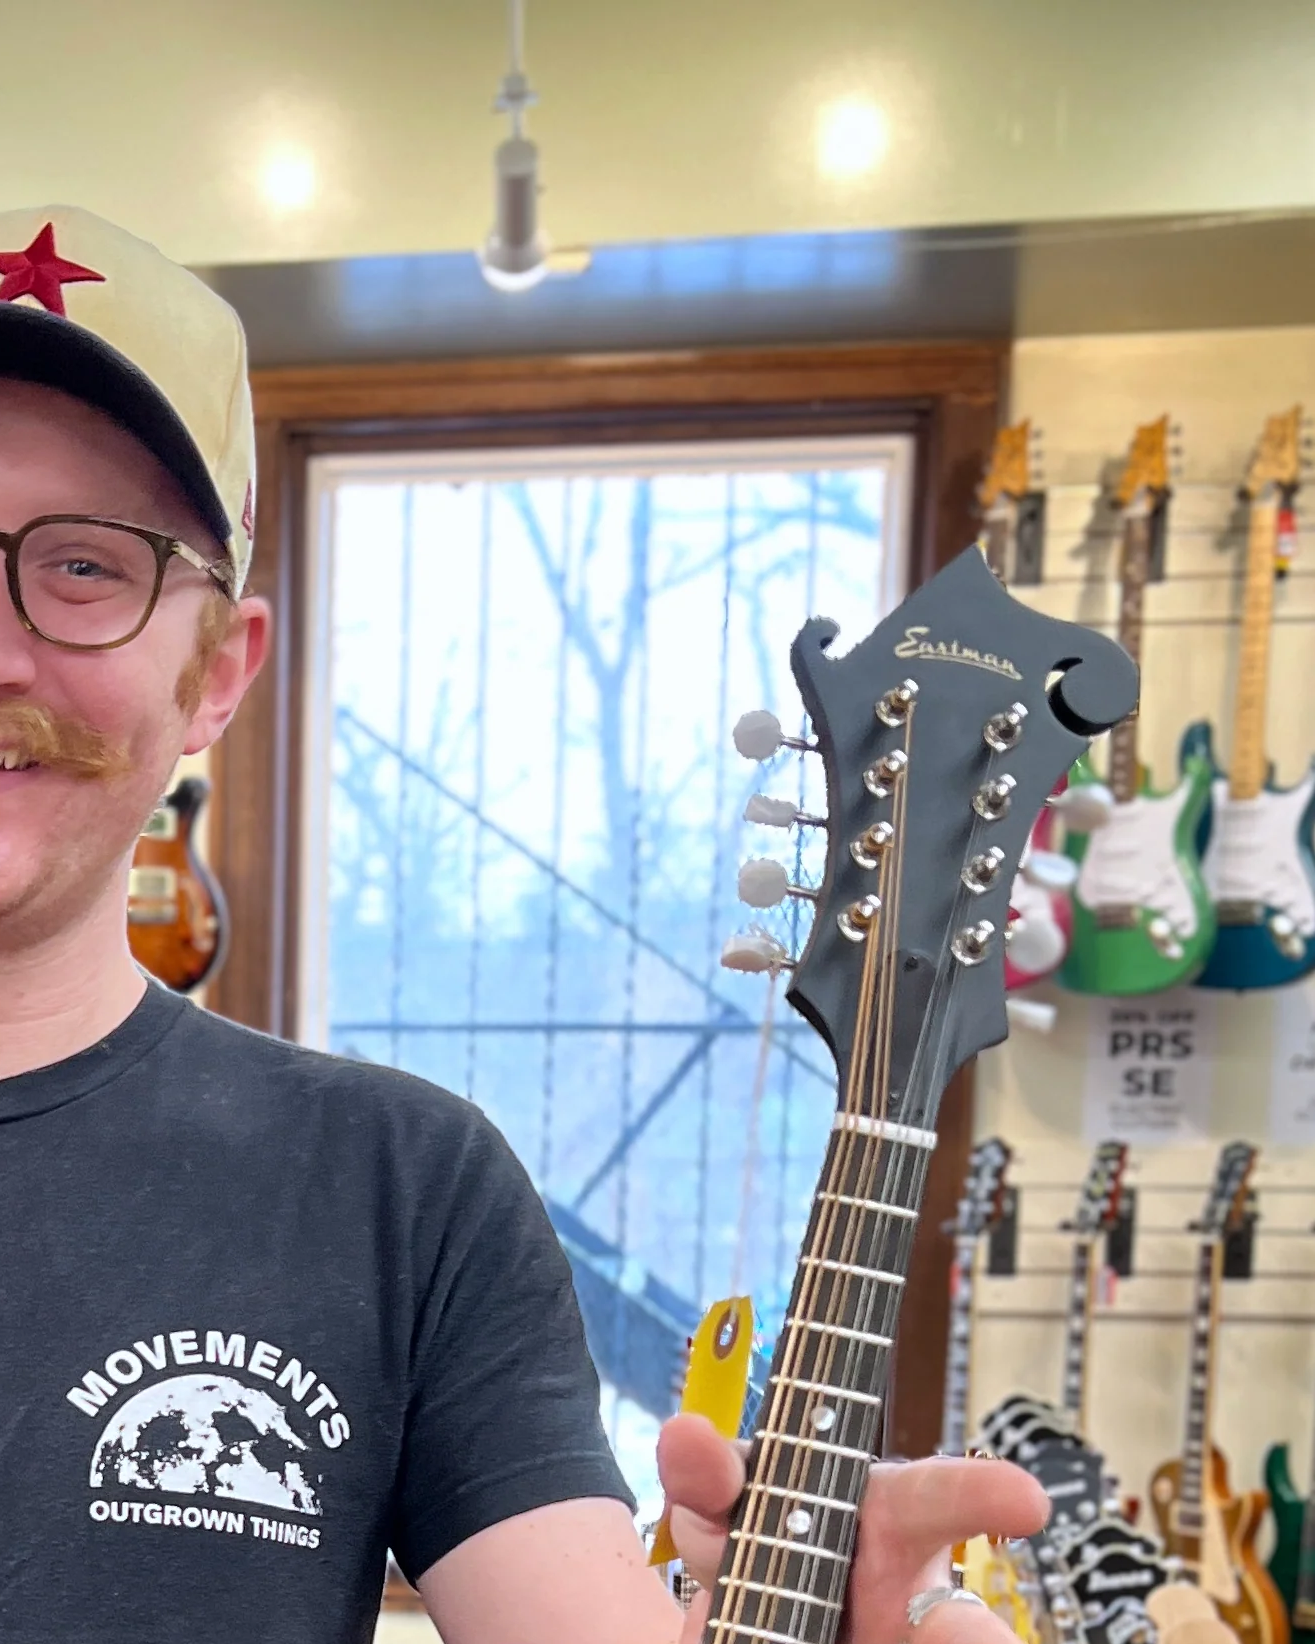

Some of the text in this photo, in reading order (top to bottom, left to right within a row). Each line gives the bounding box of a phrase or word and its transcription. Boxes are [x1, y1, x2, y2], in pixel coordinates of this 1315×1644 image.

[893, 625, 1024, 681] Eastman
[1108, 1030, 1194, 1059] PRS
[1122, 1067, 1177, 1098] SE
[66, 1330, 351, 1449] MOVEMENTS
[89, 1500, 322, 1549] OUTGROWN THINGS
